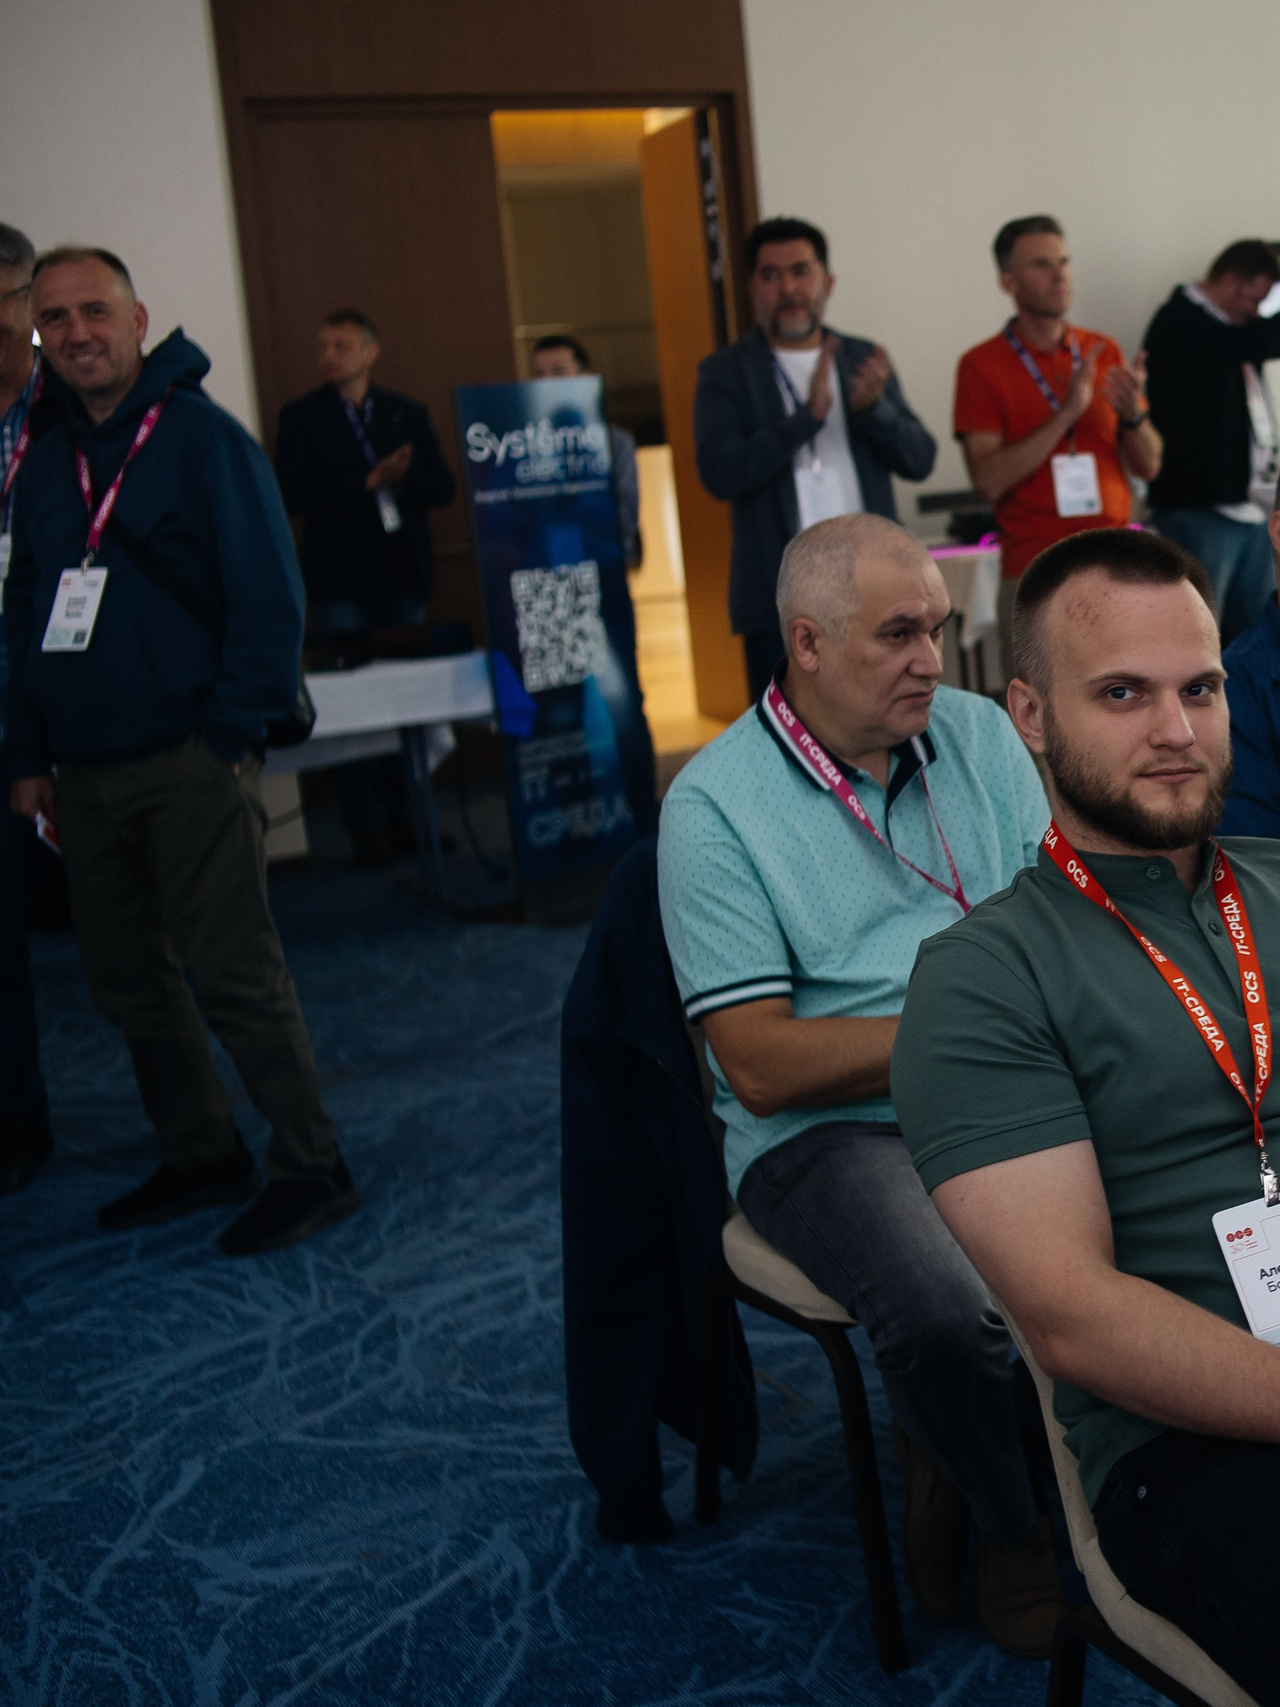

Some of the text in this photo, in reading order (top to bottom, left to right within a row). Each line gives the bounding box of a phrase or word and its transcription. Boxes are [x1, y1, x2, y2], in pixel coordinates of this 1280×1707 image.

[777, 701, 867, 820] OCS IT-СРЕДА OCS
[1066, 859, 1089, 889] OCS
[1139, 936, 1167, 963] OCS
[1172, 977, 1225, 1052] IT-СРЕДА
[1221, 893, 1251, 955] IT-СРЕДА
[1243, 971, 1261, 1004] OCS
